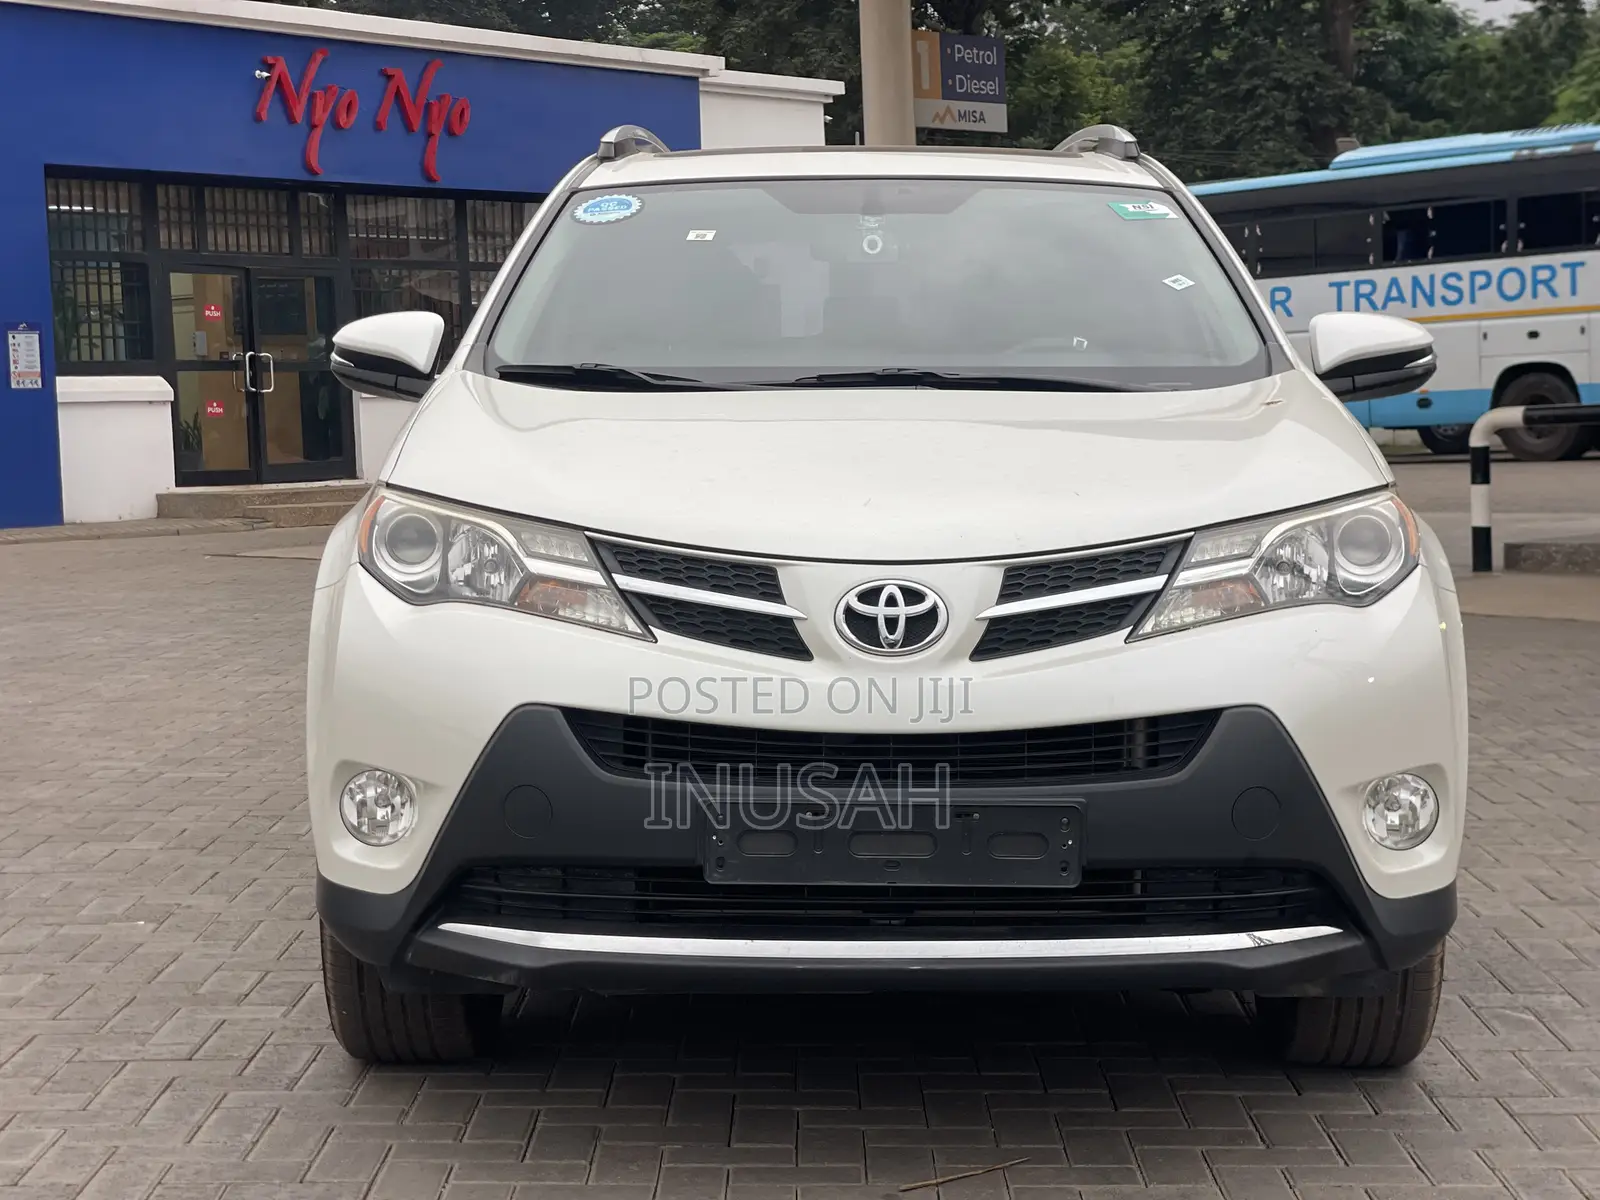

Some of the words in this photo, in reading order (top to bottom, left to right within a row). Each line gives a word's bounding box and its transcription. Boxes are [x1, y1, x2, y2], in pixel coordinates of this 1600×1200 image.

[916, 40, 930, 90] 1
[954, 44, 997, 65] Petrol
[955, 74, 999, 95] Diesel
[255, 48, 359, 175] Nyo
[376, 58, 471, 182] Nyo
[957, 109, 986, 124] MISA
[1328, 261, 1586, 312] TRANSPORT
